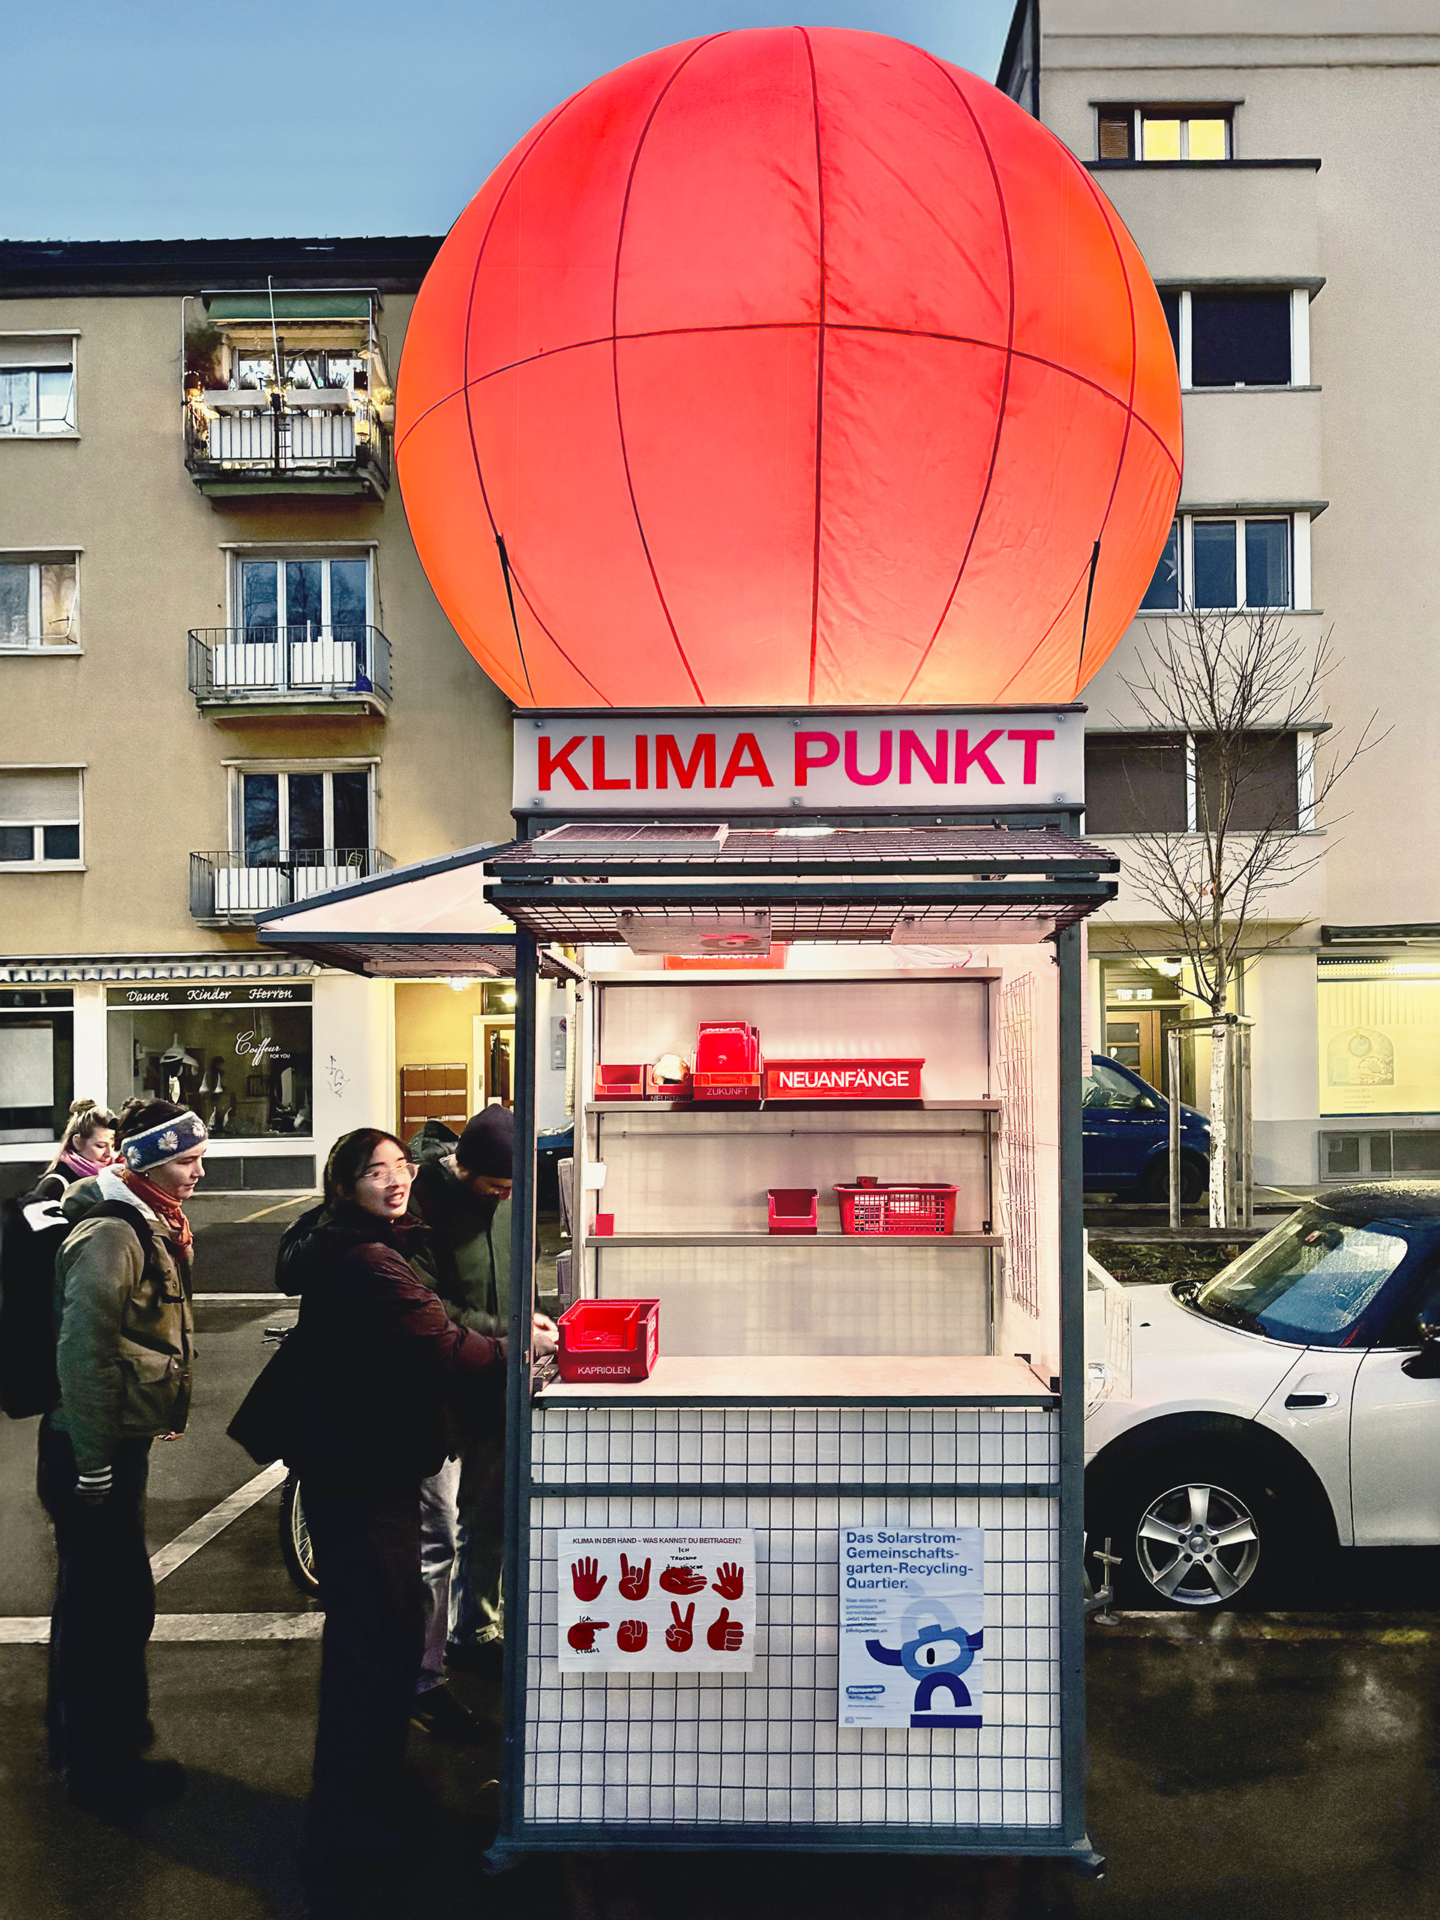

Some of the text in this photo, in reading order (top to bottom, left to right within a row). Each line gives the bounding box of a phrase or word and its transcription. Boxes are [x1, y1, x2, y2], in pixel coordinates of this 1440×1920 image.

[538, 729, 1055, 791] KLIMA PUNKT
[126, 987, 293, 1002] Damen Kinder Herren
[235, 1030, 281, 1067] Coiffeur
[779, 1068, 909, 1088] NEUANFÄNGE
[706, 1087, 749, 1096] ZUKUNFT
[577, 1366, 631, 1375] KAPRIOLEN
[846, 1531, 962, 1544] Das Solarstrom-
[846, 1546, 960, 1559] Gemeinschafts-
[846, 1562, 974, 1577] garten-Recycling-
[846, 1577, 909, 1589] Quartier.
